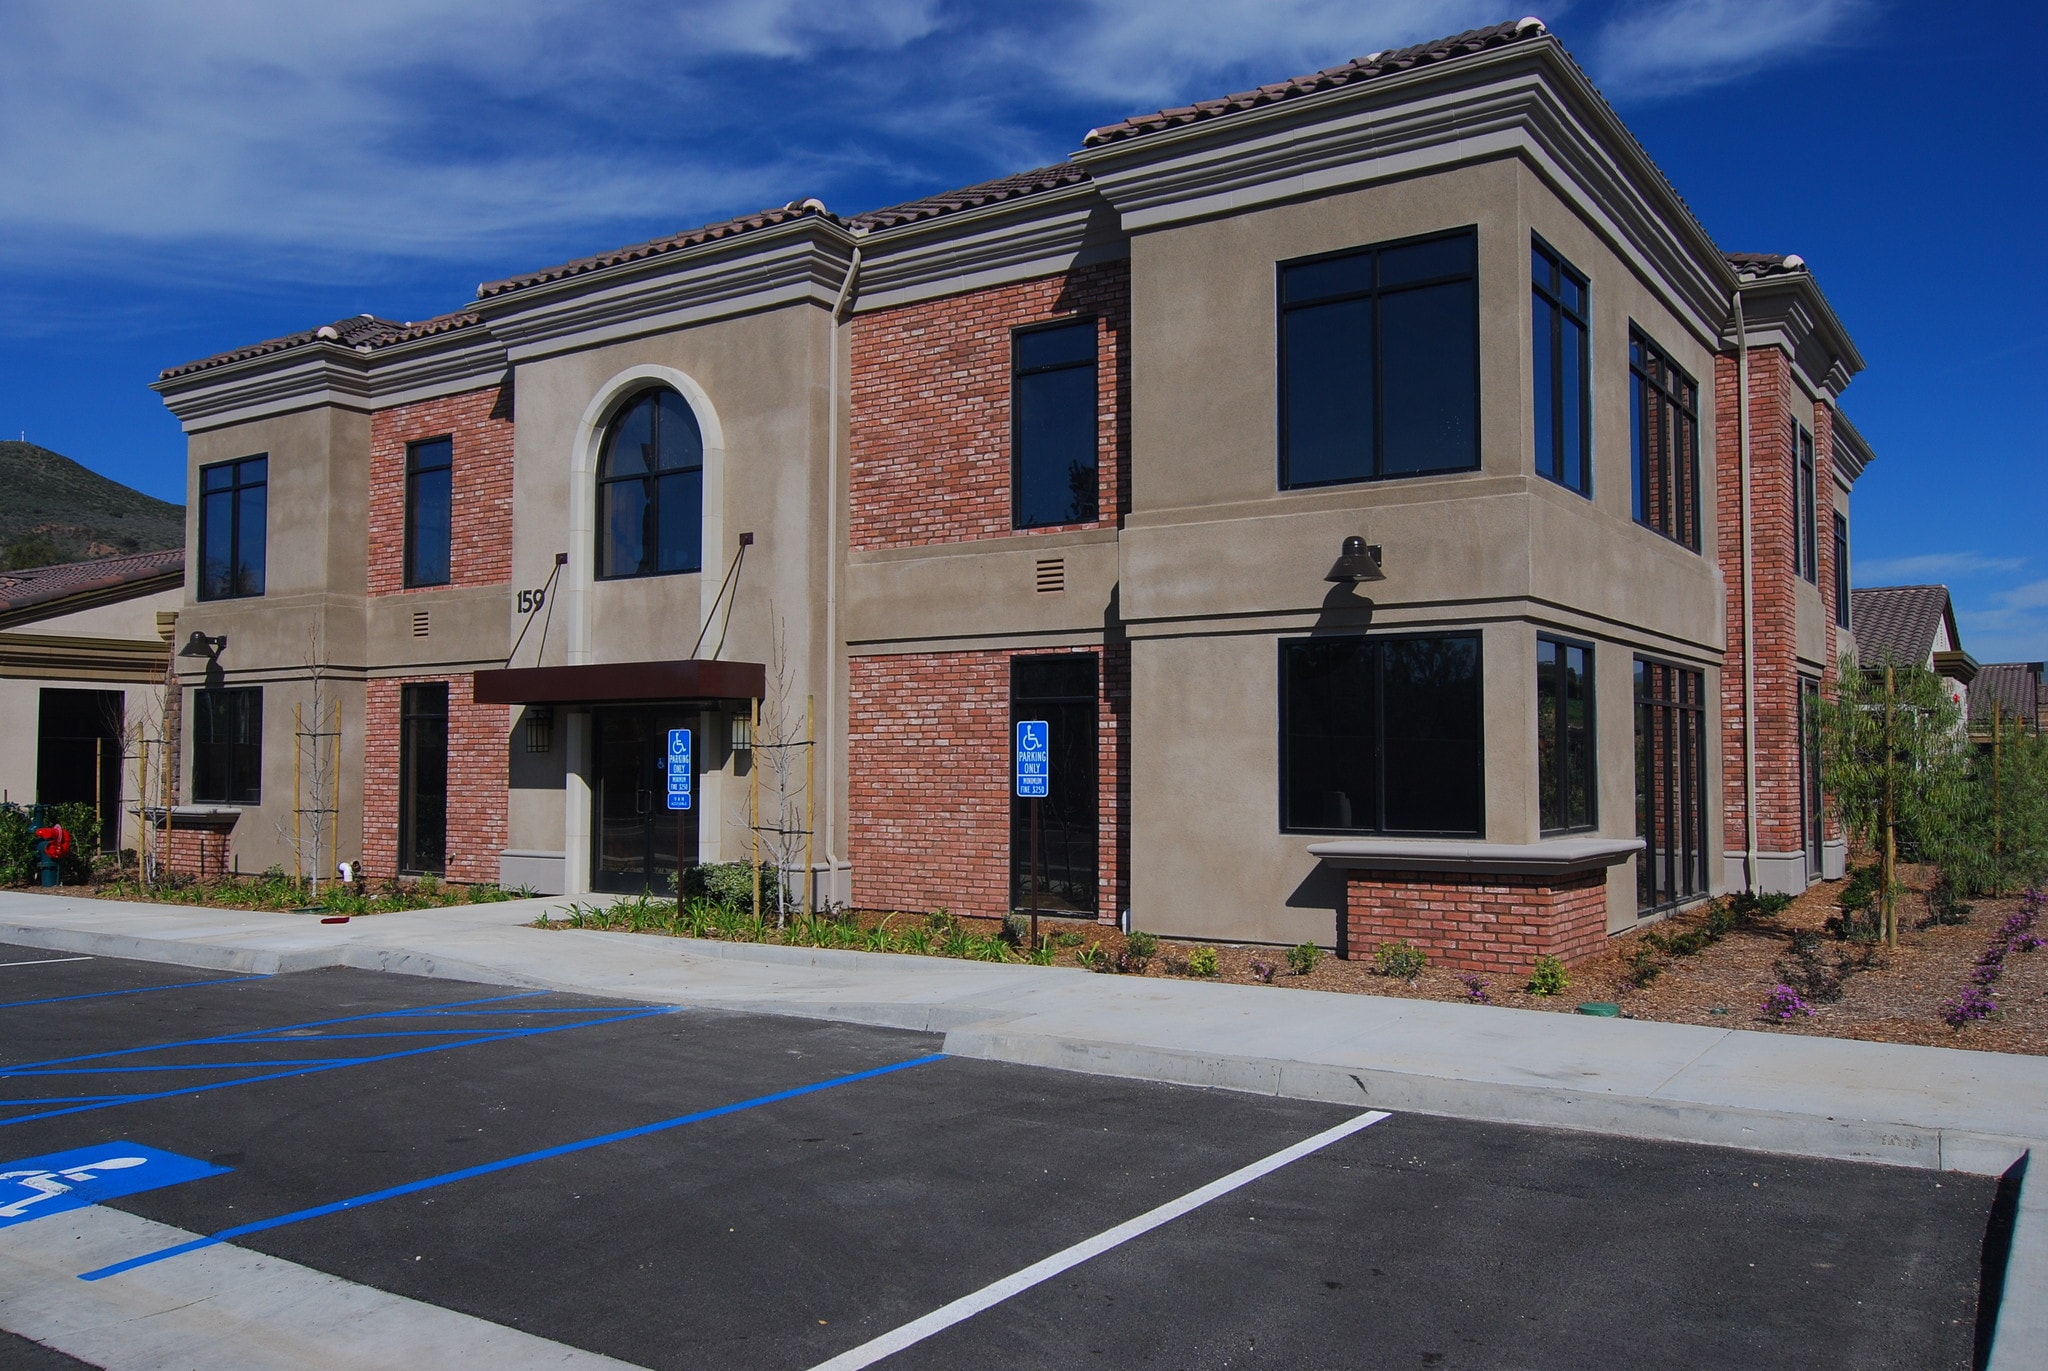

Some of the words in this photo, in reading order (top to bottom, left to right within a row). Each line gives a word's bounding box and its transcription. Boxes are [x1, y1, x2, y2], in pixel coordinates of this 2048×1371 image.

[517, 589, 545, 613] 159
[669, 754, 689, 764] PARKING
[1019, 751, 1047, 762] PARKING
[673, 764, 685, 774] ONLY
[1024, 763, 1041, 774] ONLY
[1023, 777, 1043, 785] MINIMUM
[1020, 785, 1031, 794] FINE
[1032, 785, 1045, 794] $250
